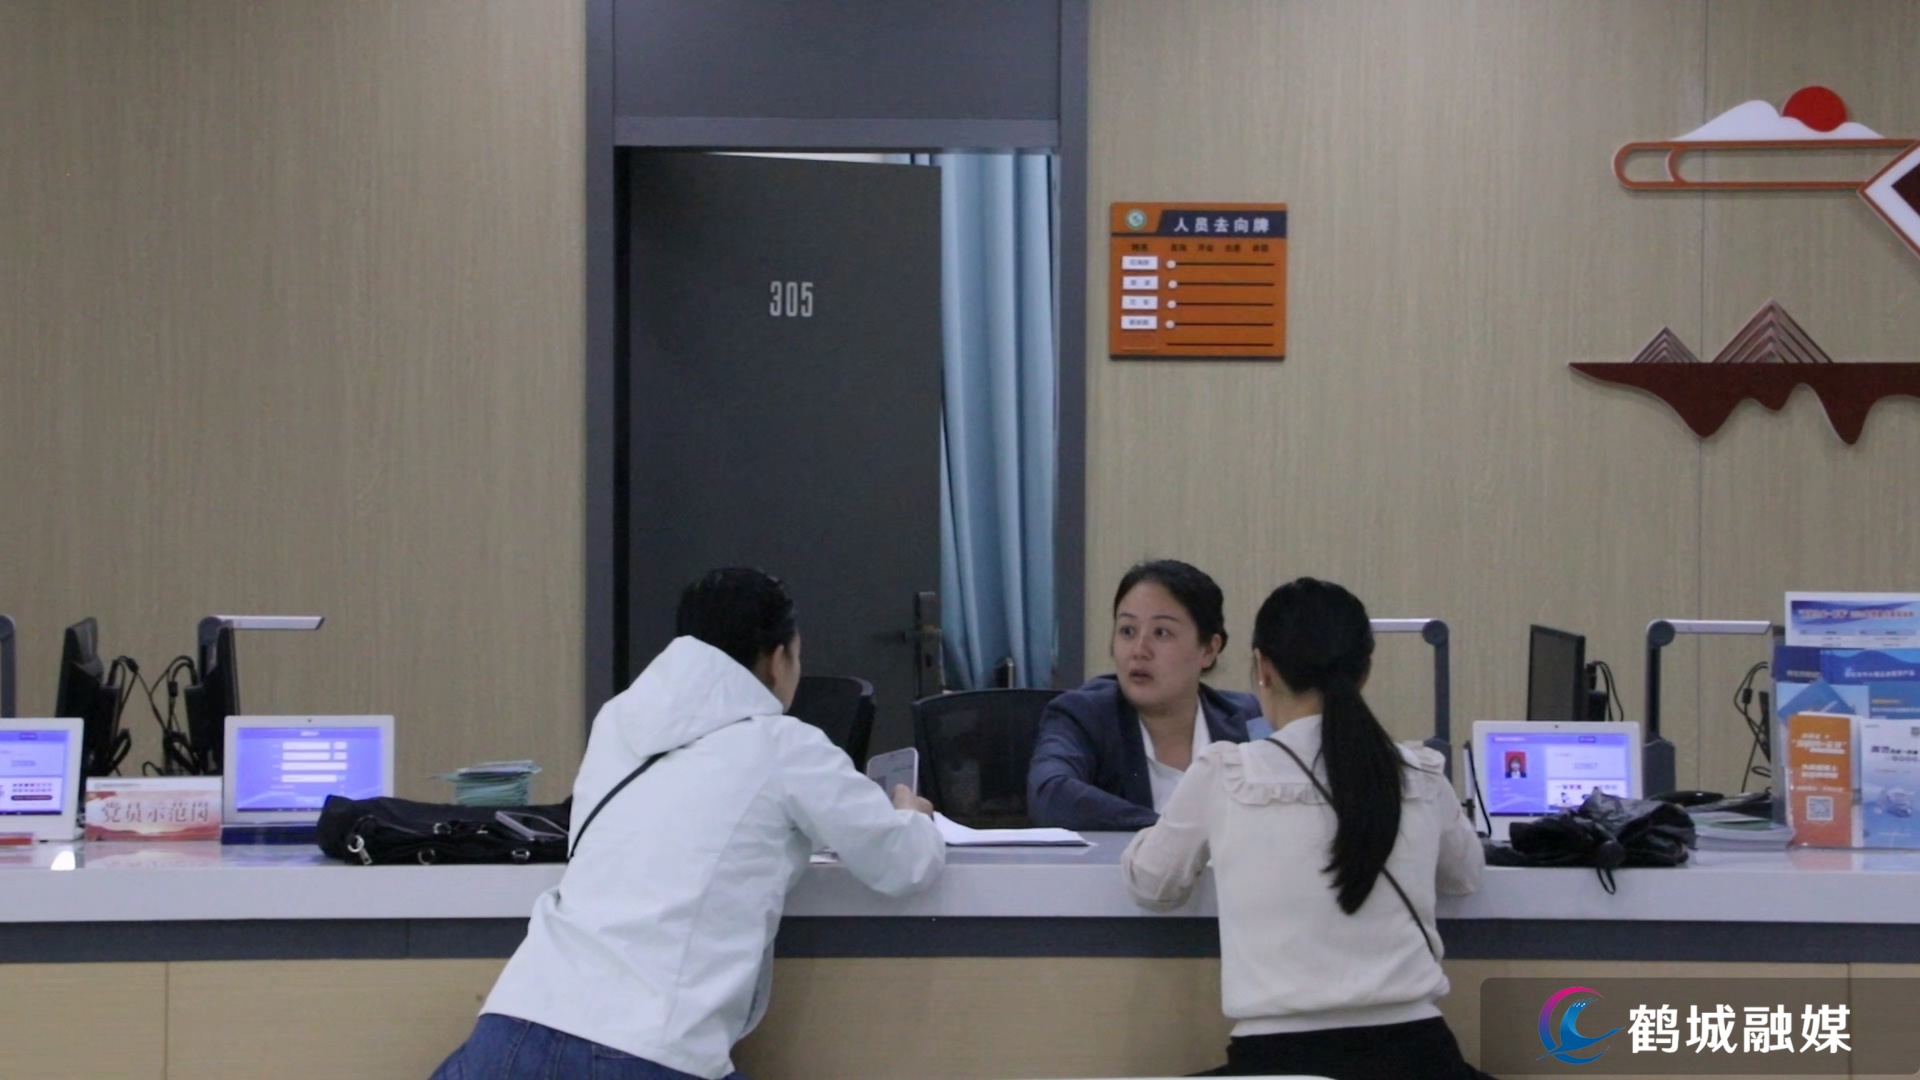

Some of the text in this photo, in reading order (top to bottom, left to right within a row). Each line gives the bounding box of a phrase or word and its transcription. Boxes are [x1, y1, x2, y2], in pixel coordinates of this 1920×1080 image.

[1174, 217, 1270, 233] 人员去向牌
[769, 281, 814, 317] 305
[102, 801, 210, 823] 党员示范岗
